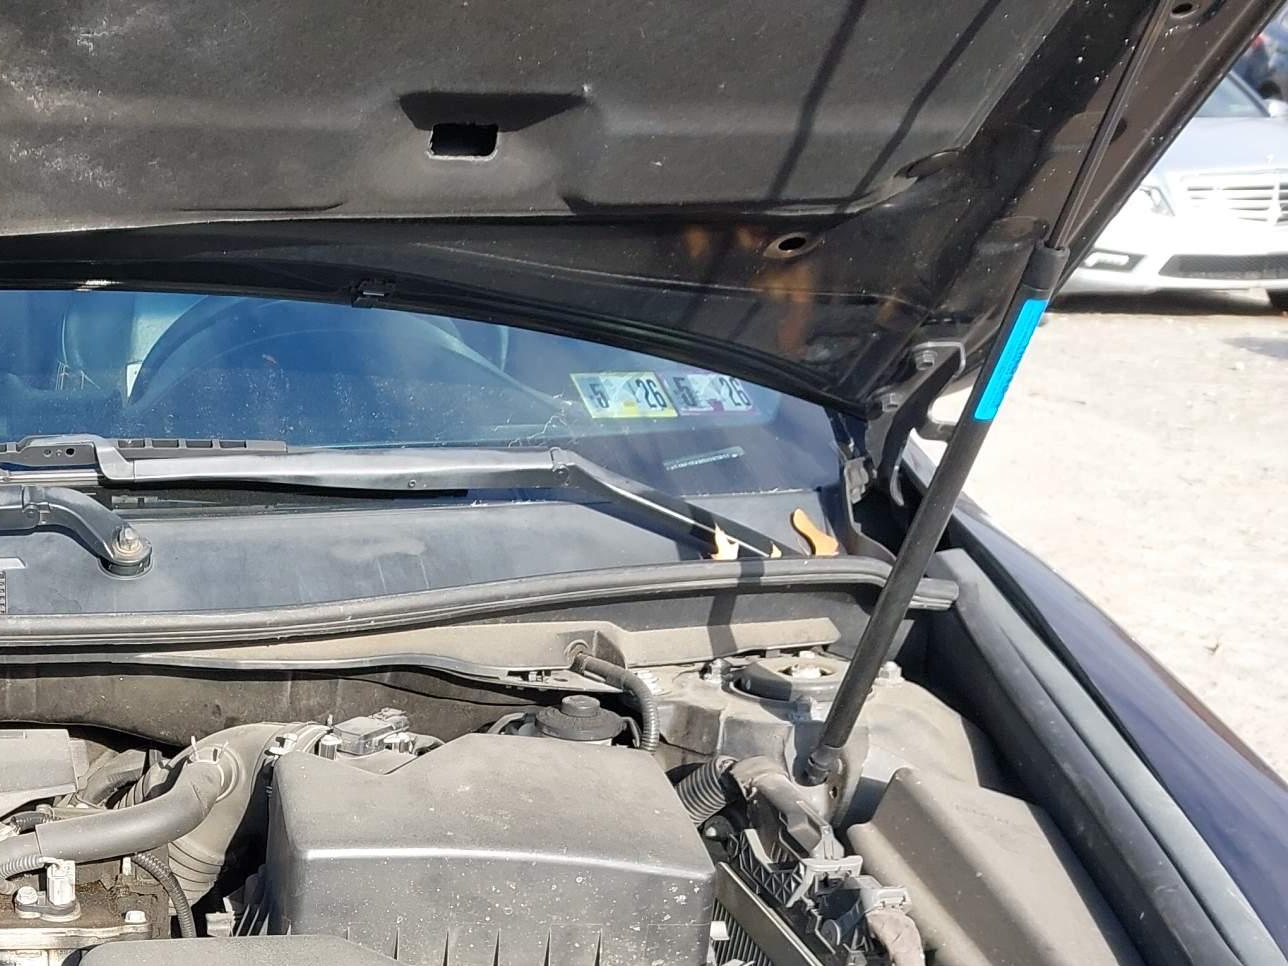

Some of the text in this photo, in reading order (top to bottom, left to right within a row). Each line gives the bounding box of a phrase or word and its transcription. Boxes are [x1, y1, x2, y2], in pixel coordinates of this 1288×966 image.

[589, 378, 668, 409] 5 26
[672, 376, 751, 408] 5 26
